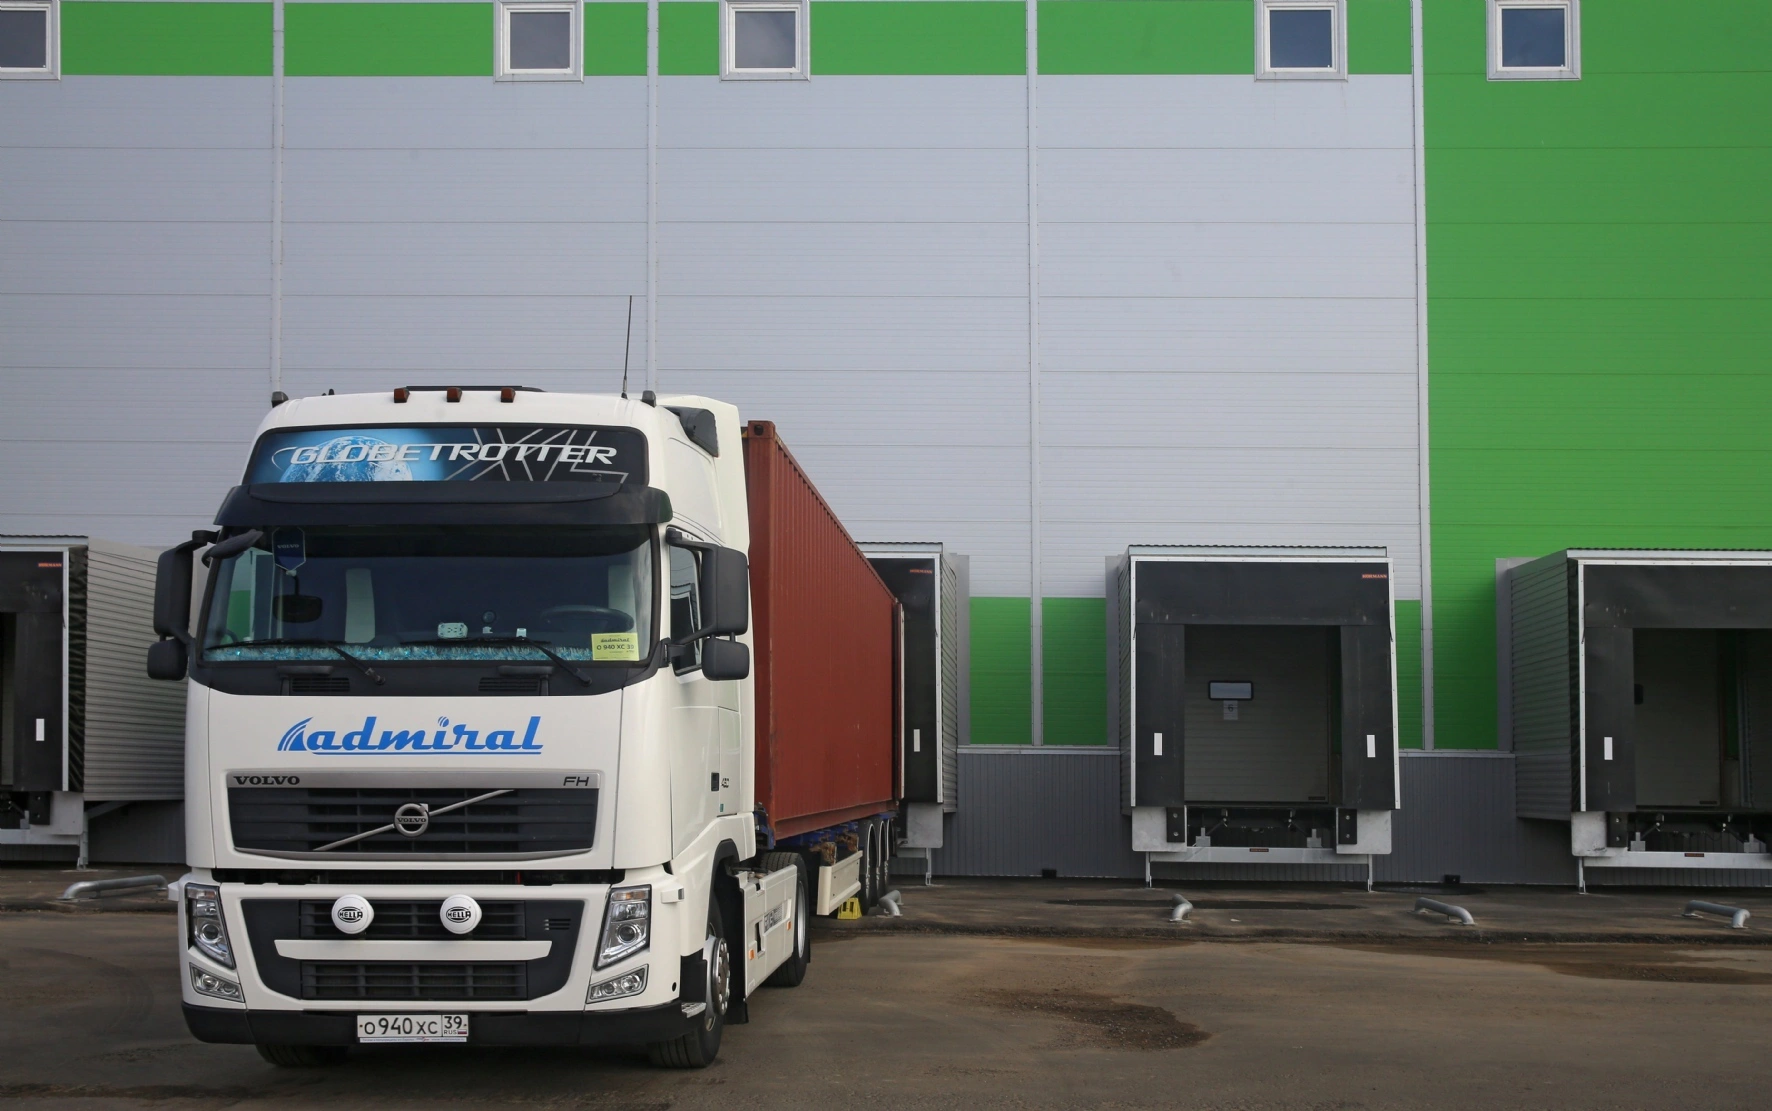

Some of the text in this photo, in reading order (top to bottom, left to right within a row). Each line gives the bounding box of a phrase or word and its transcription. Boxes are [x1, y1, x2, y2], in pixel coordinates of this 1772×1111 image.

[289, 443, 618, 466] GLOBETROTTER
[305, 715, 545, 752] admiral
[233, 776, 301, 786] VOLVO
[563, 776, 590, 787] FH
[338, 910, 364, 920] HELLA
[447, 909, 472, 919] HELLA
[444, 1015, 463, 1030] 39
